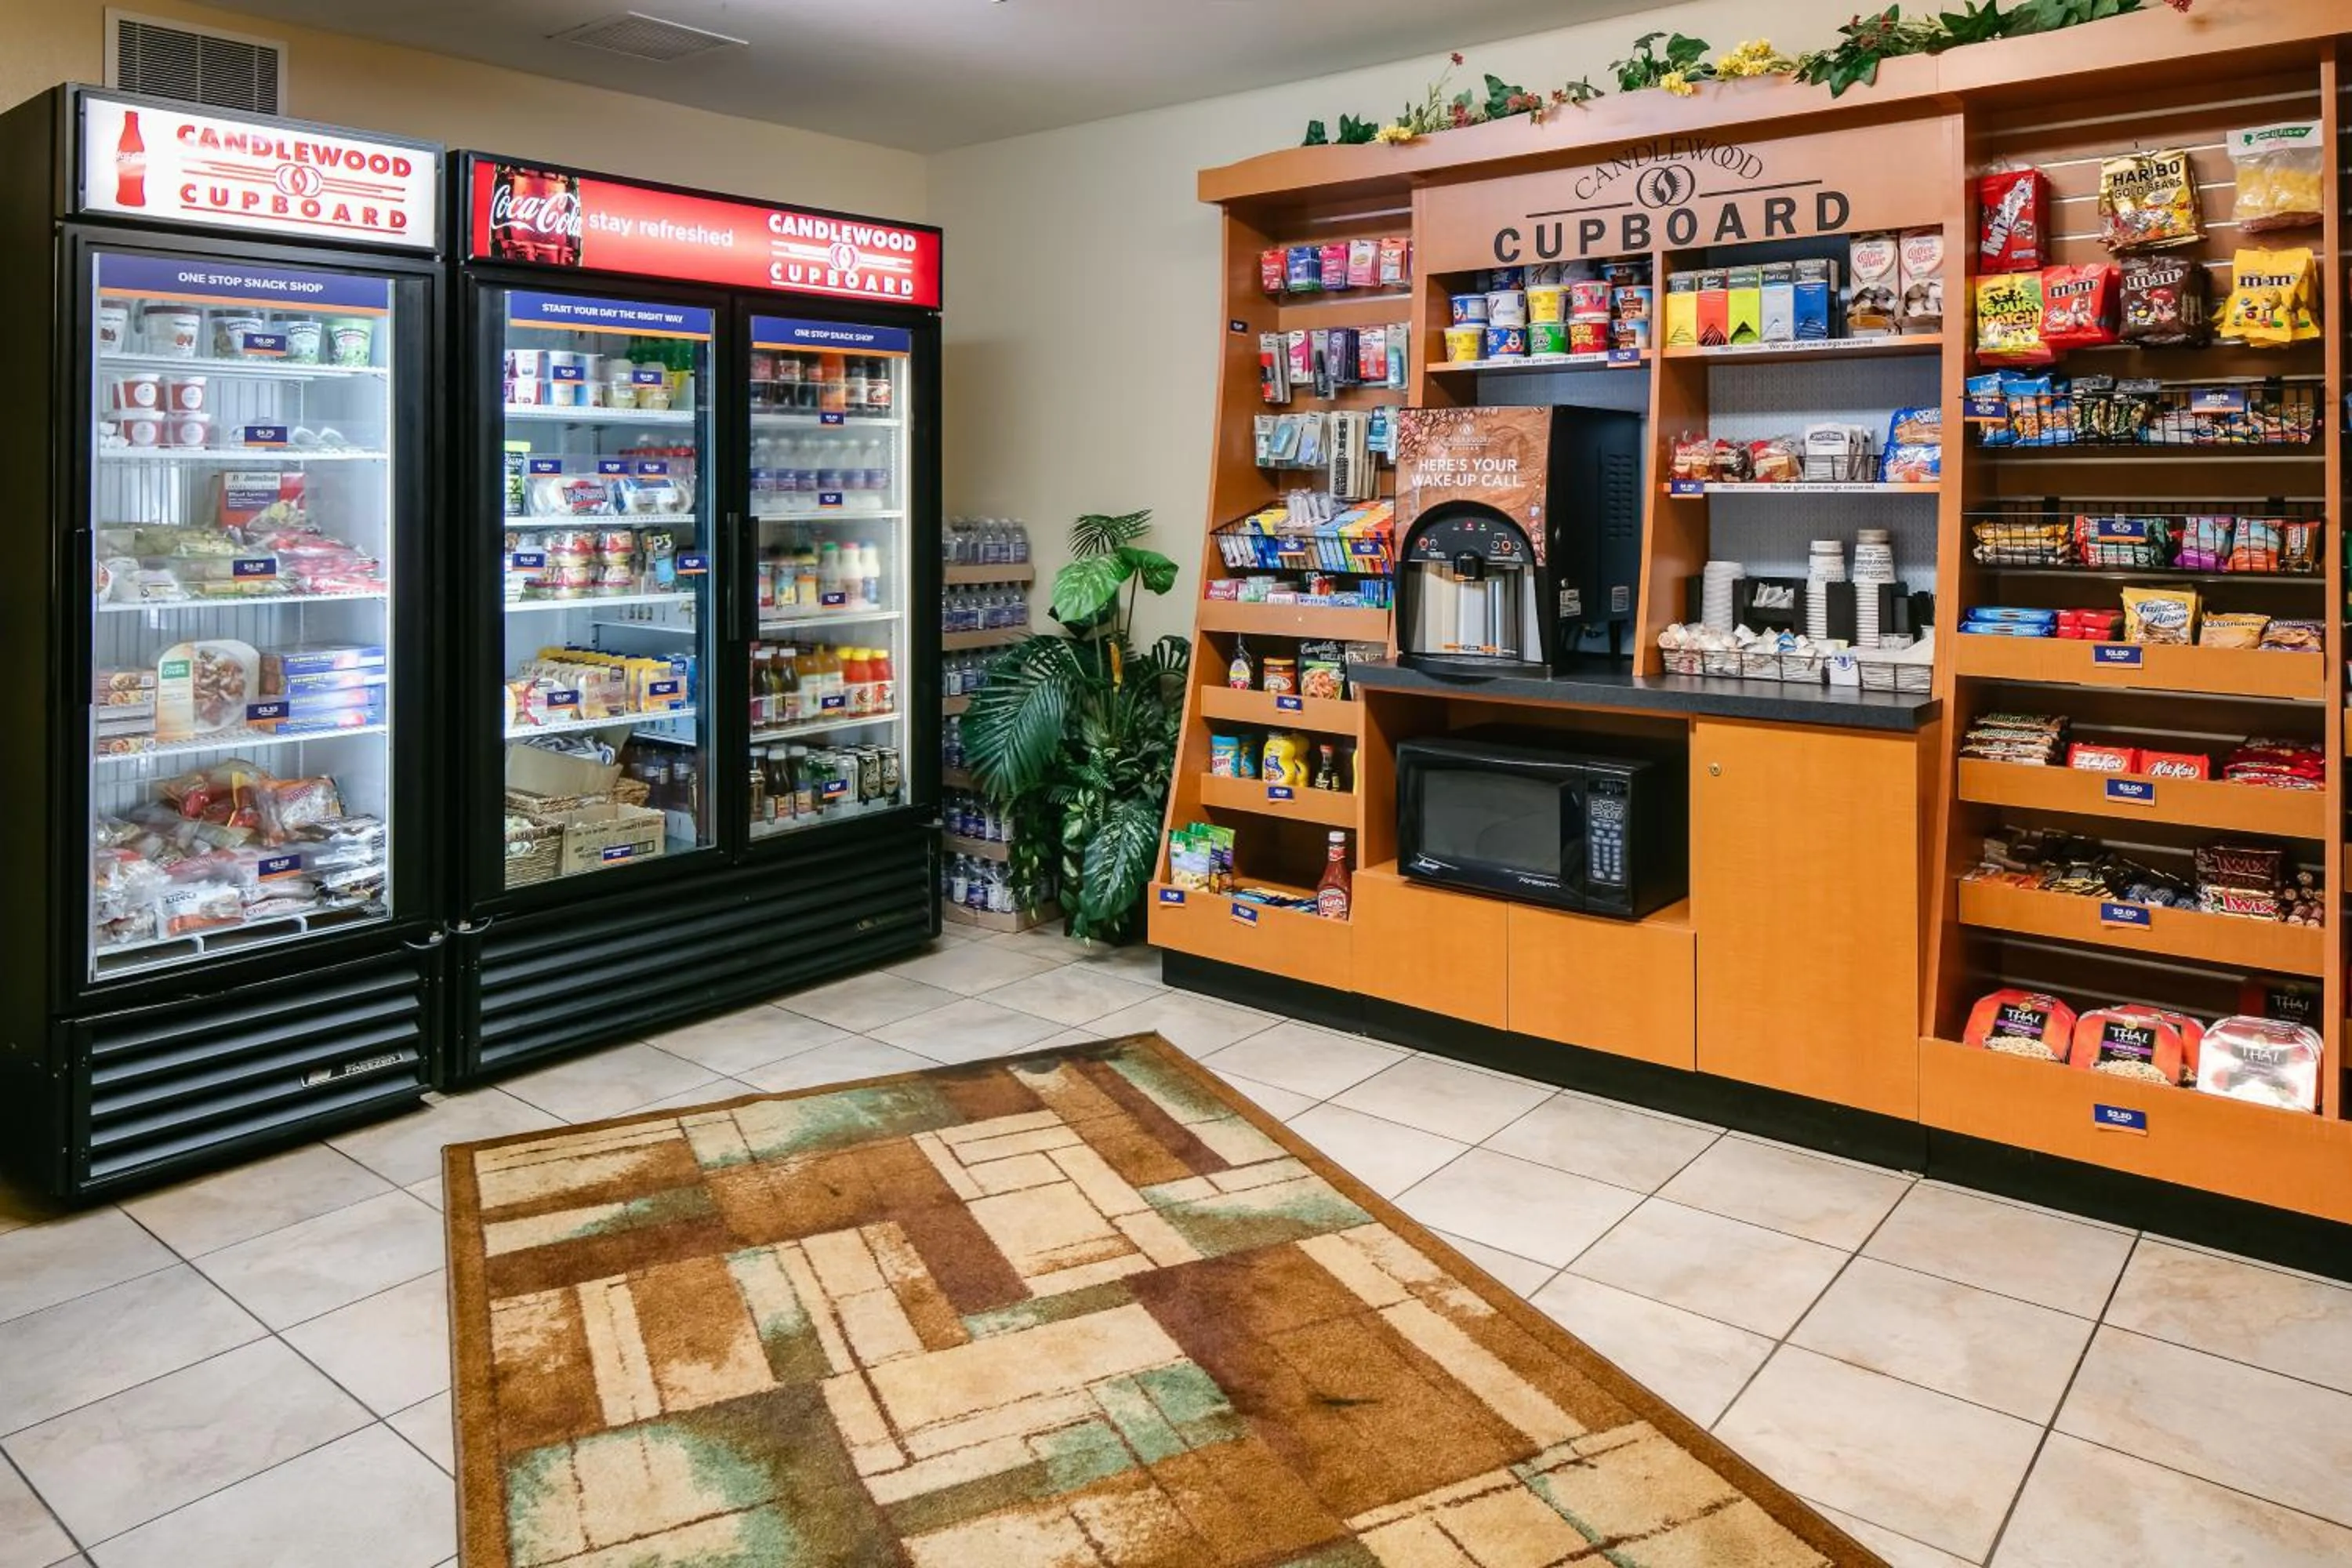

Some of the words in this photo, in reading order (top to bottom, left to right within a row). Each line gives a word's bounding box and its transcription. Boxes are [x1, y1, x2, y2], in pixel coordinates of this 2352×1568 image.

[176, 124, 412, 178] CANDLEWOOD
[1574, 137, 1764, 201] CANDLEWOOD
[2112, 160, 2180, 187] HARIBO
[180, 183, 408, 229] CUPBOARD
[588, 212, 633, 236] stay
[639, 219, 734, 248] refreshed
[768, 213, 917, 252] CANDLEWOOD
[1494, 190, 1850, 263] CUPBOARD
[178, 272, 206, 283] ONE
[208, 275, 242, 286] STOP
[244, 278, 288, 290] SNACK
[289, 281, 324, 293] SHOP
[770, 262, 914, 296] CUPBOARD
[542, 303, 573, 314] START
[573, 307, 598, 317] YOUR
[600, 308, 619, 318] DAY
[619, 310, 636, 319] THE
[637, 311, 663, 322] RIGHT
[666, 314, 684, 324] WAY
[1983, 300, 2037, 315] SOUR
[794, 328, 810, 338] ONE
[811, 330, 830, 339] STOP
[830, 332, 854, 341] SNACK
[855, 333, 875, 342] SHOP
[1418, 458, 1468, 472] HERE'S
[1472, 458, 1518, 472] YOUR
[1411, 474, 1477, 487] WAKE-UP
[2272, 994, 2310, 1011] THAI
[2004, 1007, 2042, 1023] THAI
[2109, 1026, 2149, 1044] THAI
[2242, 1045, 2280, 1063] THAI
